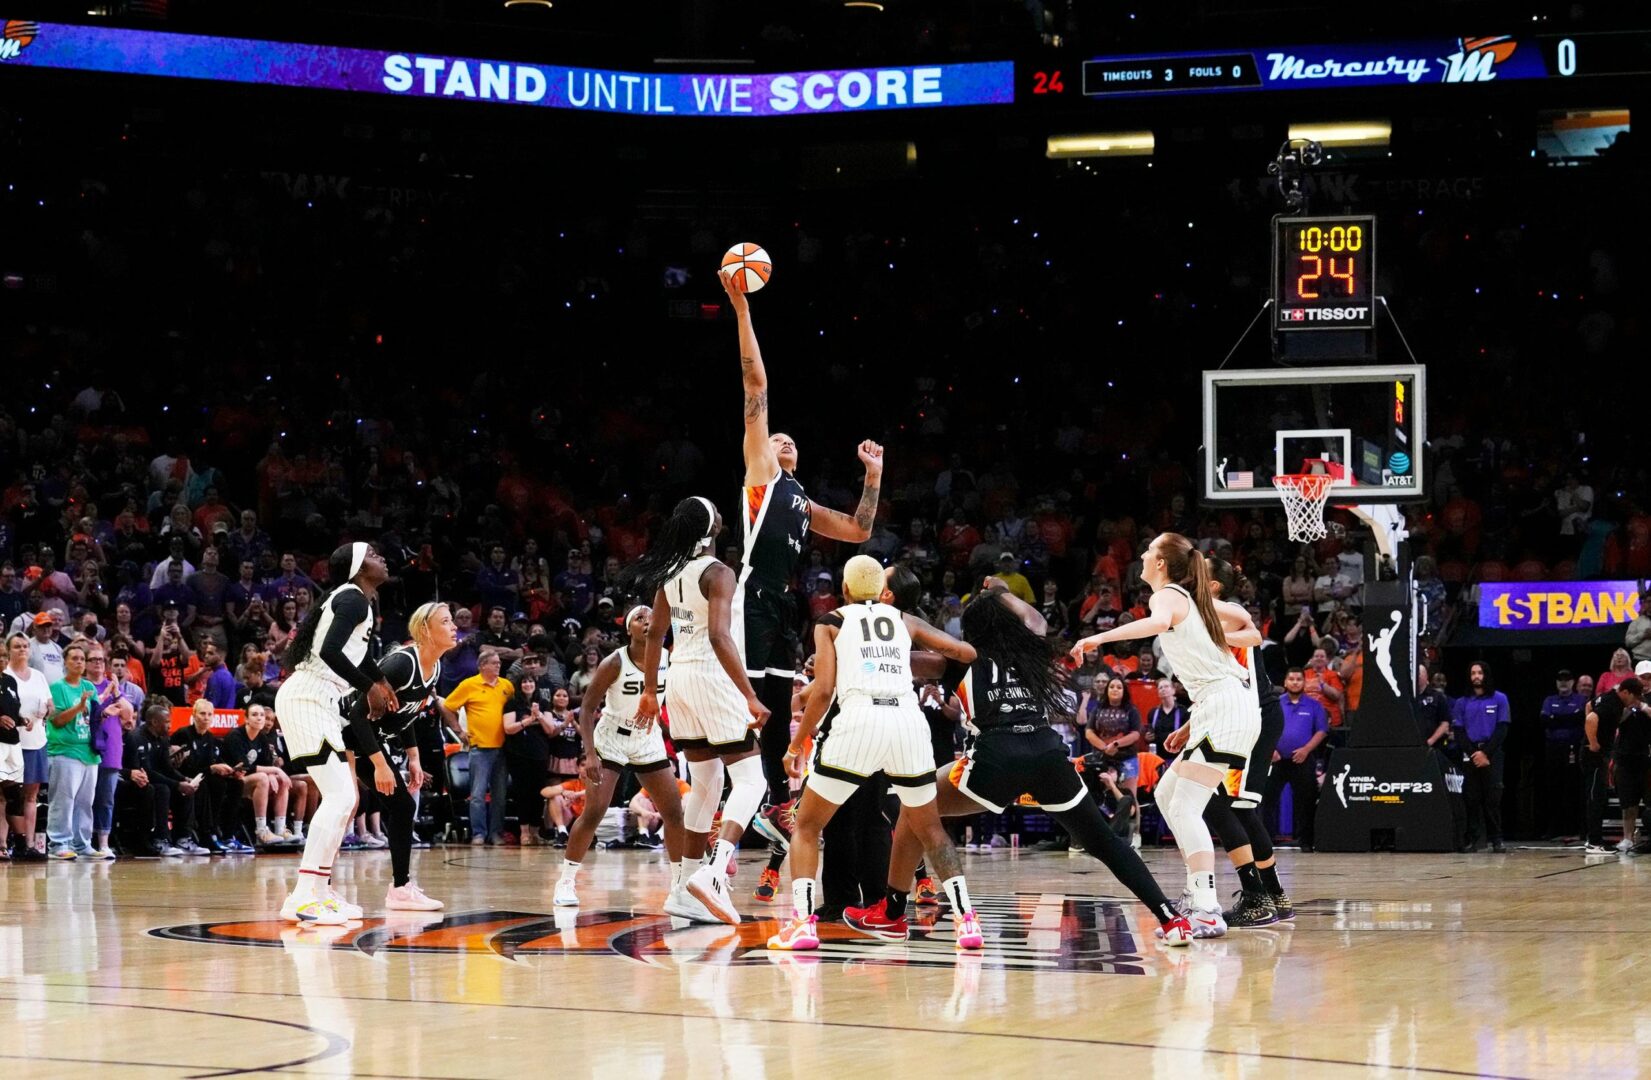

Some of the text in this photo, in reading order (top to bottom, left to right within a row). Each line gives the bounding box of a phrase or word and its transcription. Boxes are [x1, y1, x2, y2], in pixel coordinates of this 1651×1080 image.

[1558, 39, 1576, 76] 0
[1102, 69, 1173, 82] TIMEOUTS 3
[1189, 66, 1241, 78] FOULS 0
[1266, 52, 1430, 89] Mercury
[383, 53, 943, 113] STAND UNTIL WE SCORE
[1033, 71, 1063, 95] 24
[1300, 226, 1362, 252] 10:00
[1298, 255, 1354, 298] 24
[1305, 307, 1368, 321] TISSOT
[1387, 475, 1413, 486] AT&T
[679, 578, 683, 603] 1
[671, 606, 694, 622] WILLIAMS
[1493, 592, 1640, 625] 1STBANK
[860, 616, 895, 642] 10
[860, 646, 901, 660] WILLIAMS
[879, 662, 903, 675] AT&T
